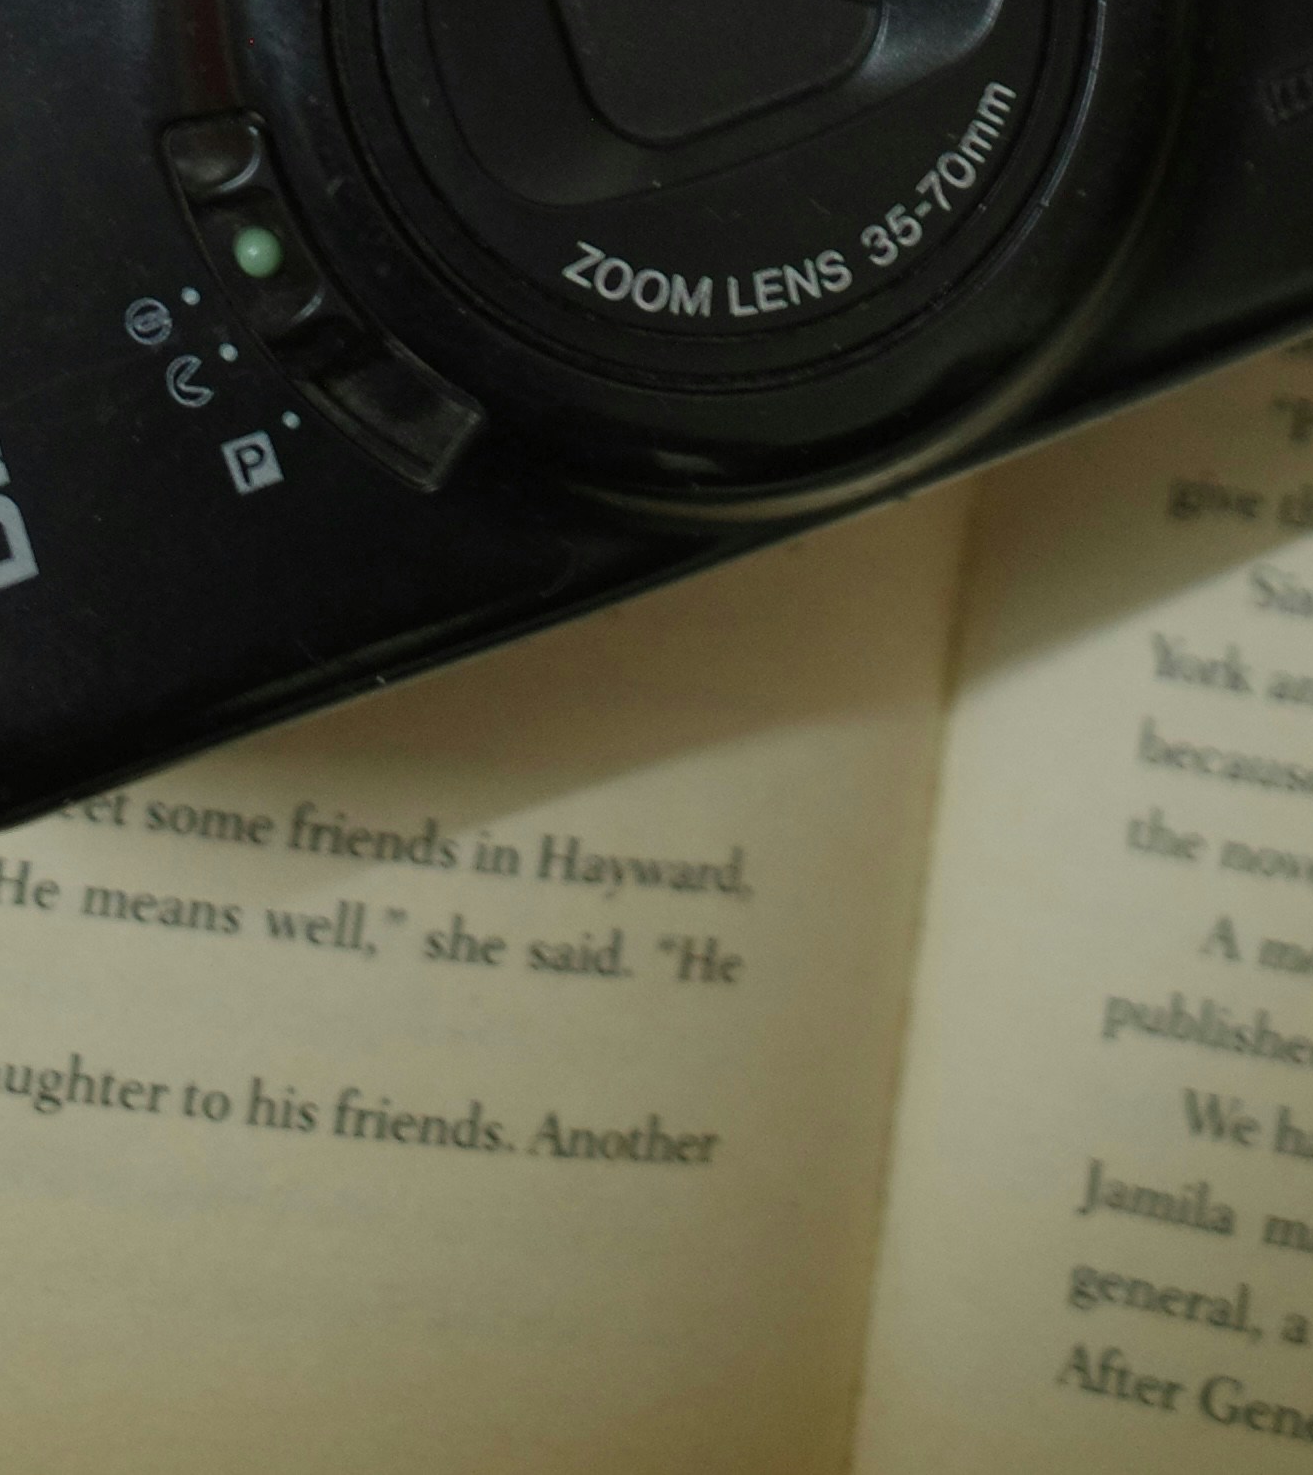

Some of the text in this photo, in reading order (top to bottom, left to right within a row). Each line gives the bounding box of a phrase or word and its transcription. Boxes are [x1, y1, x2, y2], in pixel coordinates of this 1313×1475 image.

[562, 80, 1018, 318] ZOOM LENS 35-70mm
[144, 796, 753, 901] some friends in Hayward,
[80, 886, 240, 935] means
[423, 913, 506, 966] she
[527, 928, 631, 978] said.
[181, 1082, 232, 1122] to
[245, 1076, 316, 1133] his
[332, 1087, 514, 1152] friends.
[527, 1112, 720, 1165] Another
